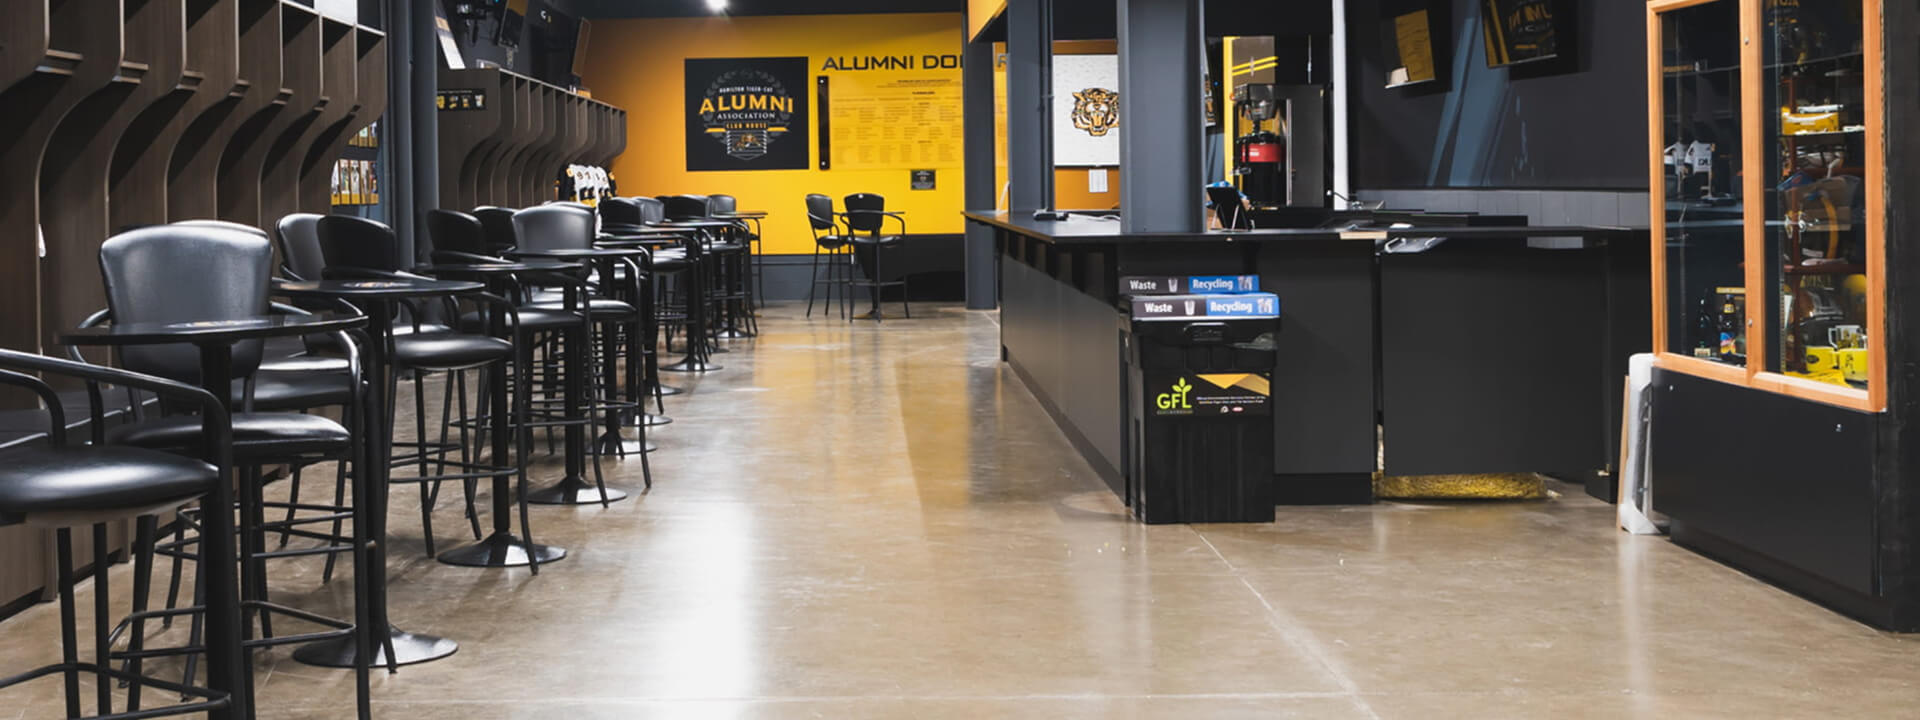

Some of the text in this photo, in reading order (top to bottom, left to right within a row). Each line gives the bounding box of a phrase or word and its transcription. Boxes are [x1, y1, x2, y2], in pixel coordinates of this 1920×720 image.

[822, 55, 914, 71] ALUMNI
[699, 93, 794, 115] ALUMNI
[717, 112, 776, 120] ASSOCIATION
[1129, 278, 1234, 290] Waste Recycling
[1144, 301, 1253, 313] Waste Recycling
[1156, 390, 1193, 409] GFL
